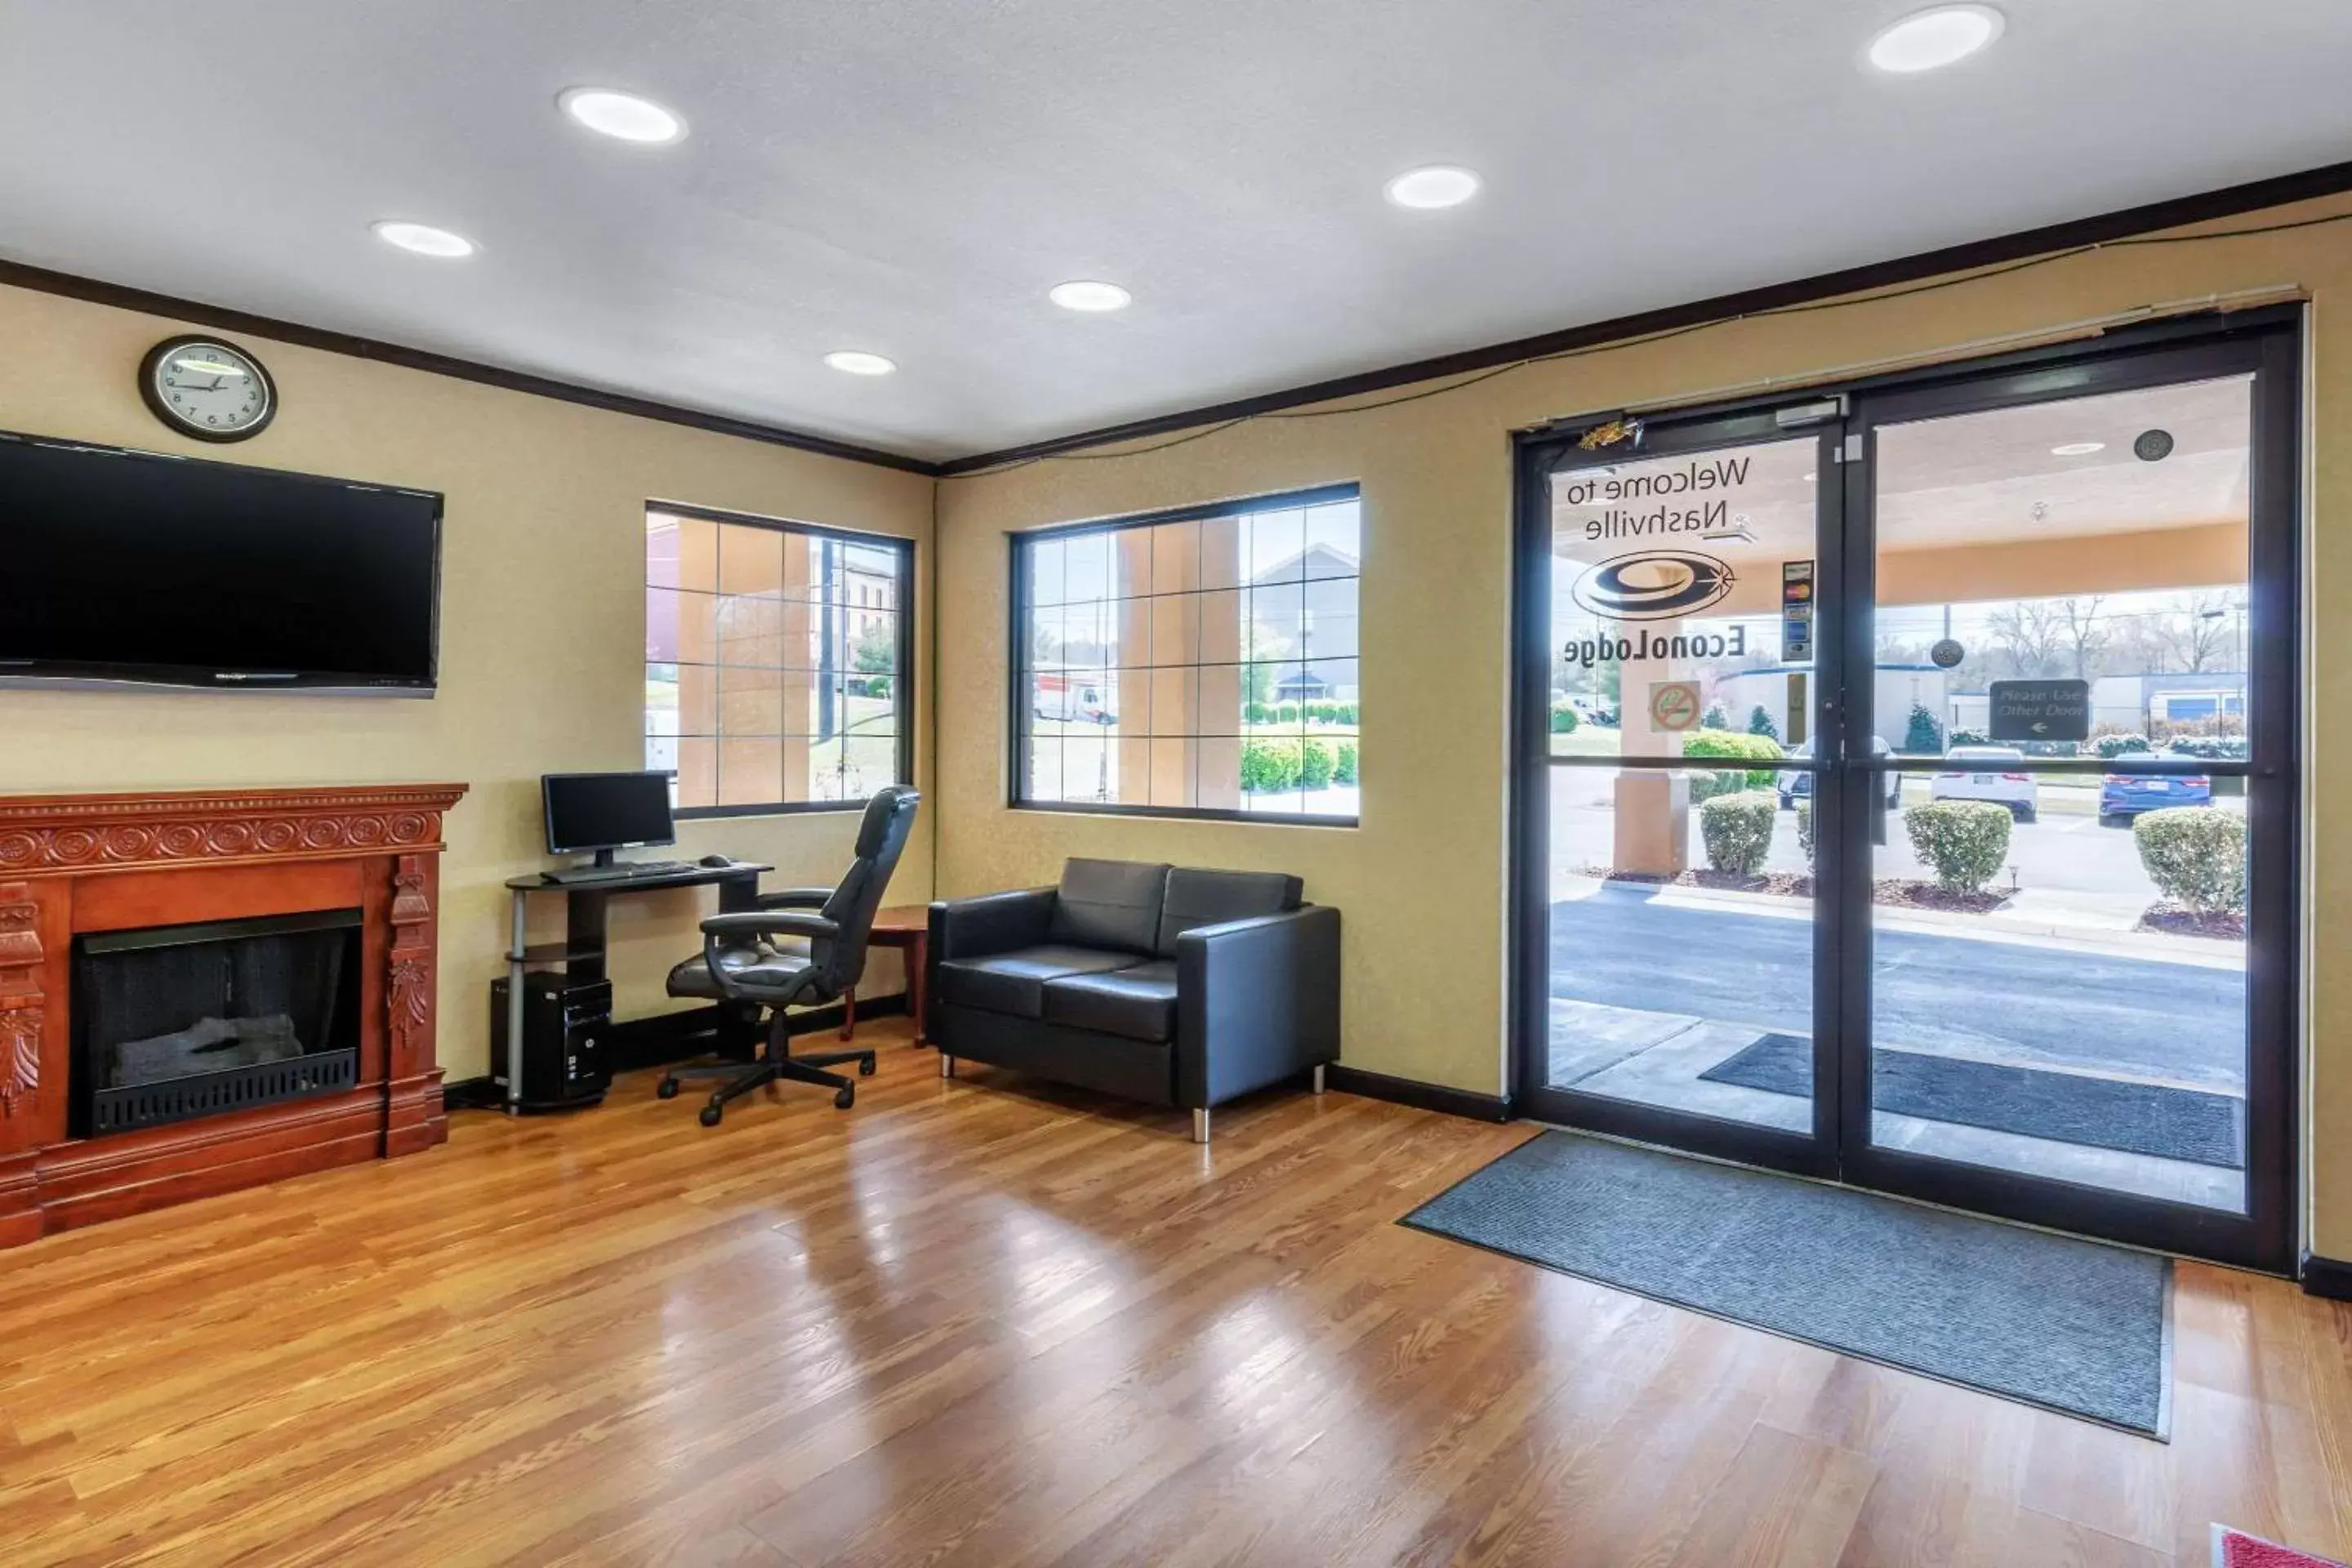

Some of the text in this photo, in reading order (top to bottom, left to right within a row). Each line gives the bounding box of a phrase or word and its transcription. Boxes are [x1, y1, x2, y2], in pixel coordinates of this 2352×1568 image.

[172, 364, 183, 374] 10
[166, 377, 175, 387] 9
[243, 376, 251, 385] 2
[173, 394, 181, 403] 8
[249, 391, 256, 401] 3
[189, 407, 197, 416] 7
[242, 404, 250, 413] 4
[207, 415, 217, 425] 6
[229, 413, 236, 423] 5
